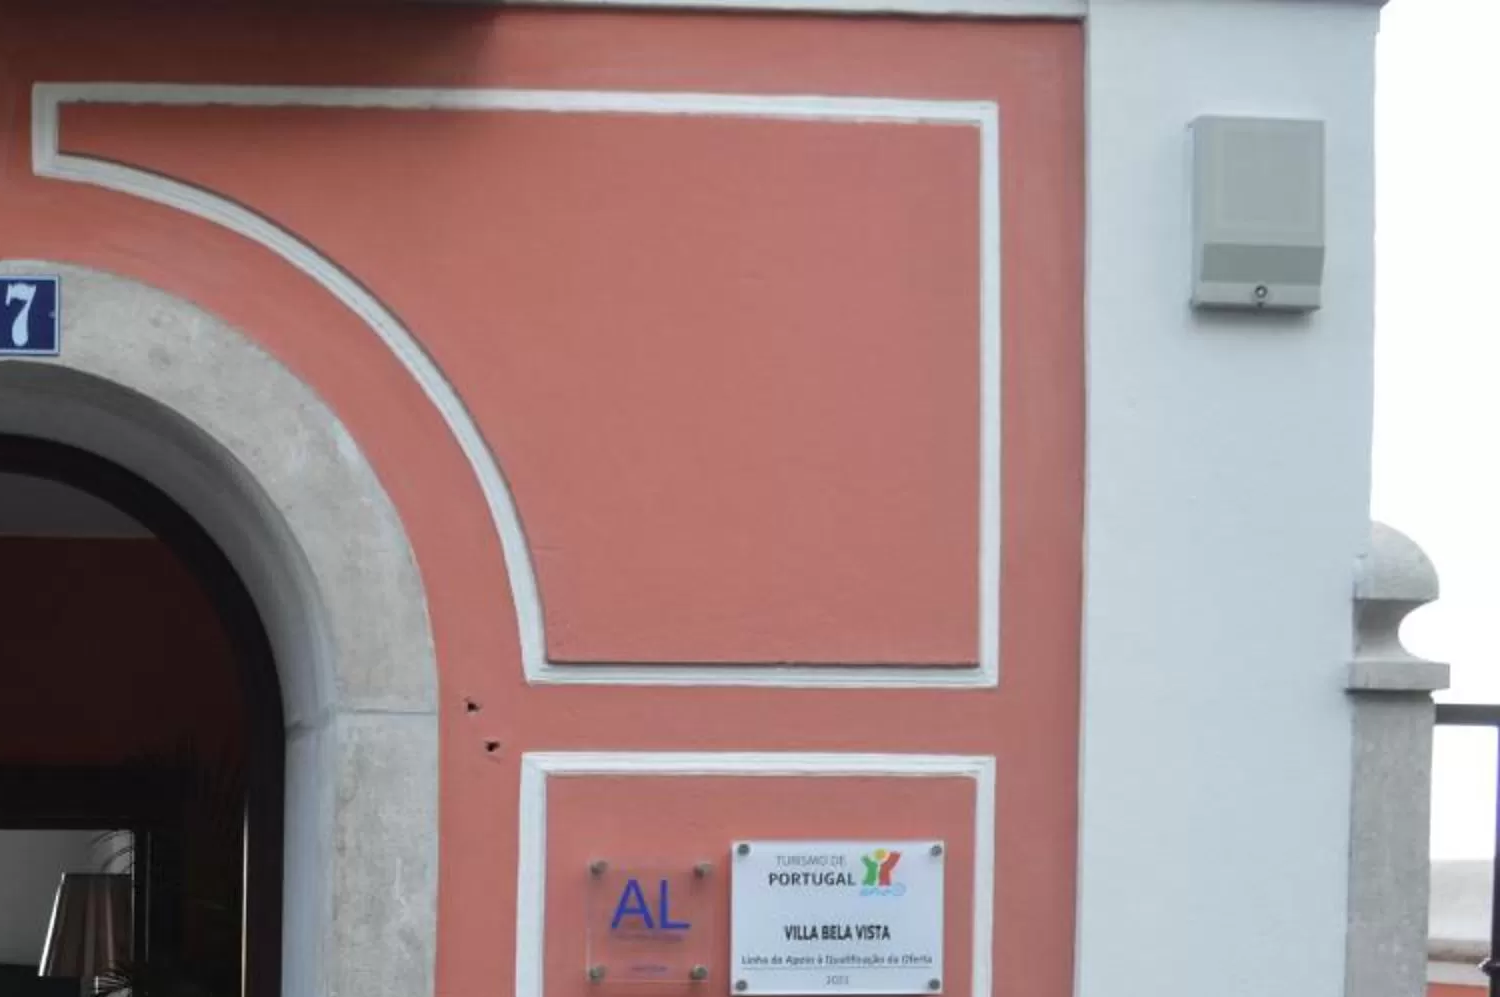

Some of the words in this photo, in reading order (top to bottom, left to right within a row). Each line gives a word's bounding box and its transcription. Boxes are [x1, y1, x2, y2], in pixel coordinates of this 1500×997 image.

[776, 855, 828, 866] TURISMO
[768, 871, 857, 887] PORTUGAL
[611, 878, 691, 929] AL
[784, 923, 819, 941] VILLA
[821, 924, 852, 941] BELA
[855, 924, 891, 941] VISTA
